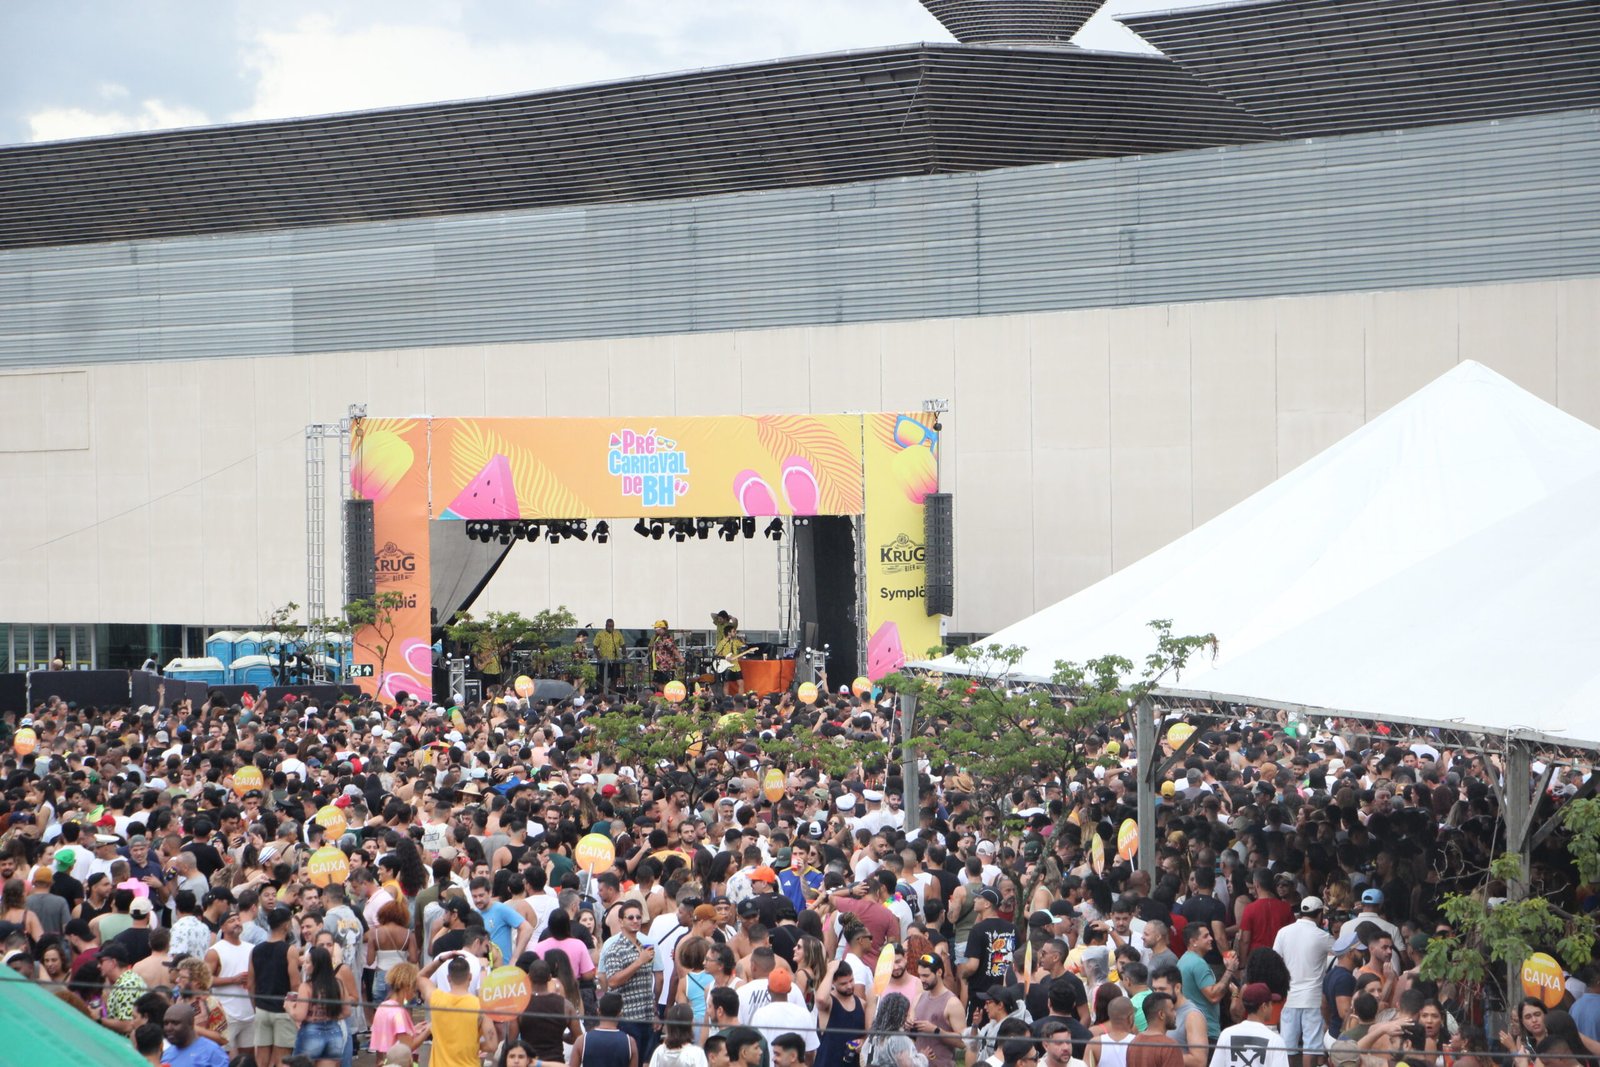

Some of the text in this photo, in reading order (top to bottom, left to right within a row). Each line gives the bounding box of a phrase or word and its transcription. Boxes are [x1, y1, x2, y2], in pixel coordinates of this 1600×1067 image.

[643, 475, 674, 505] BH
[234, 776, 261, 786] CAIXA
[578, 845, 611, 861] CAIXA
[311, 860, 346, 874] CAIXA
[1523, 967, 1561, 992] CAIXA
[482, 982, 528, 1002] CAIXA
